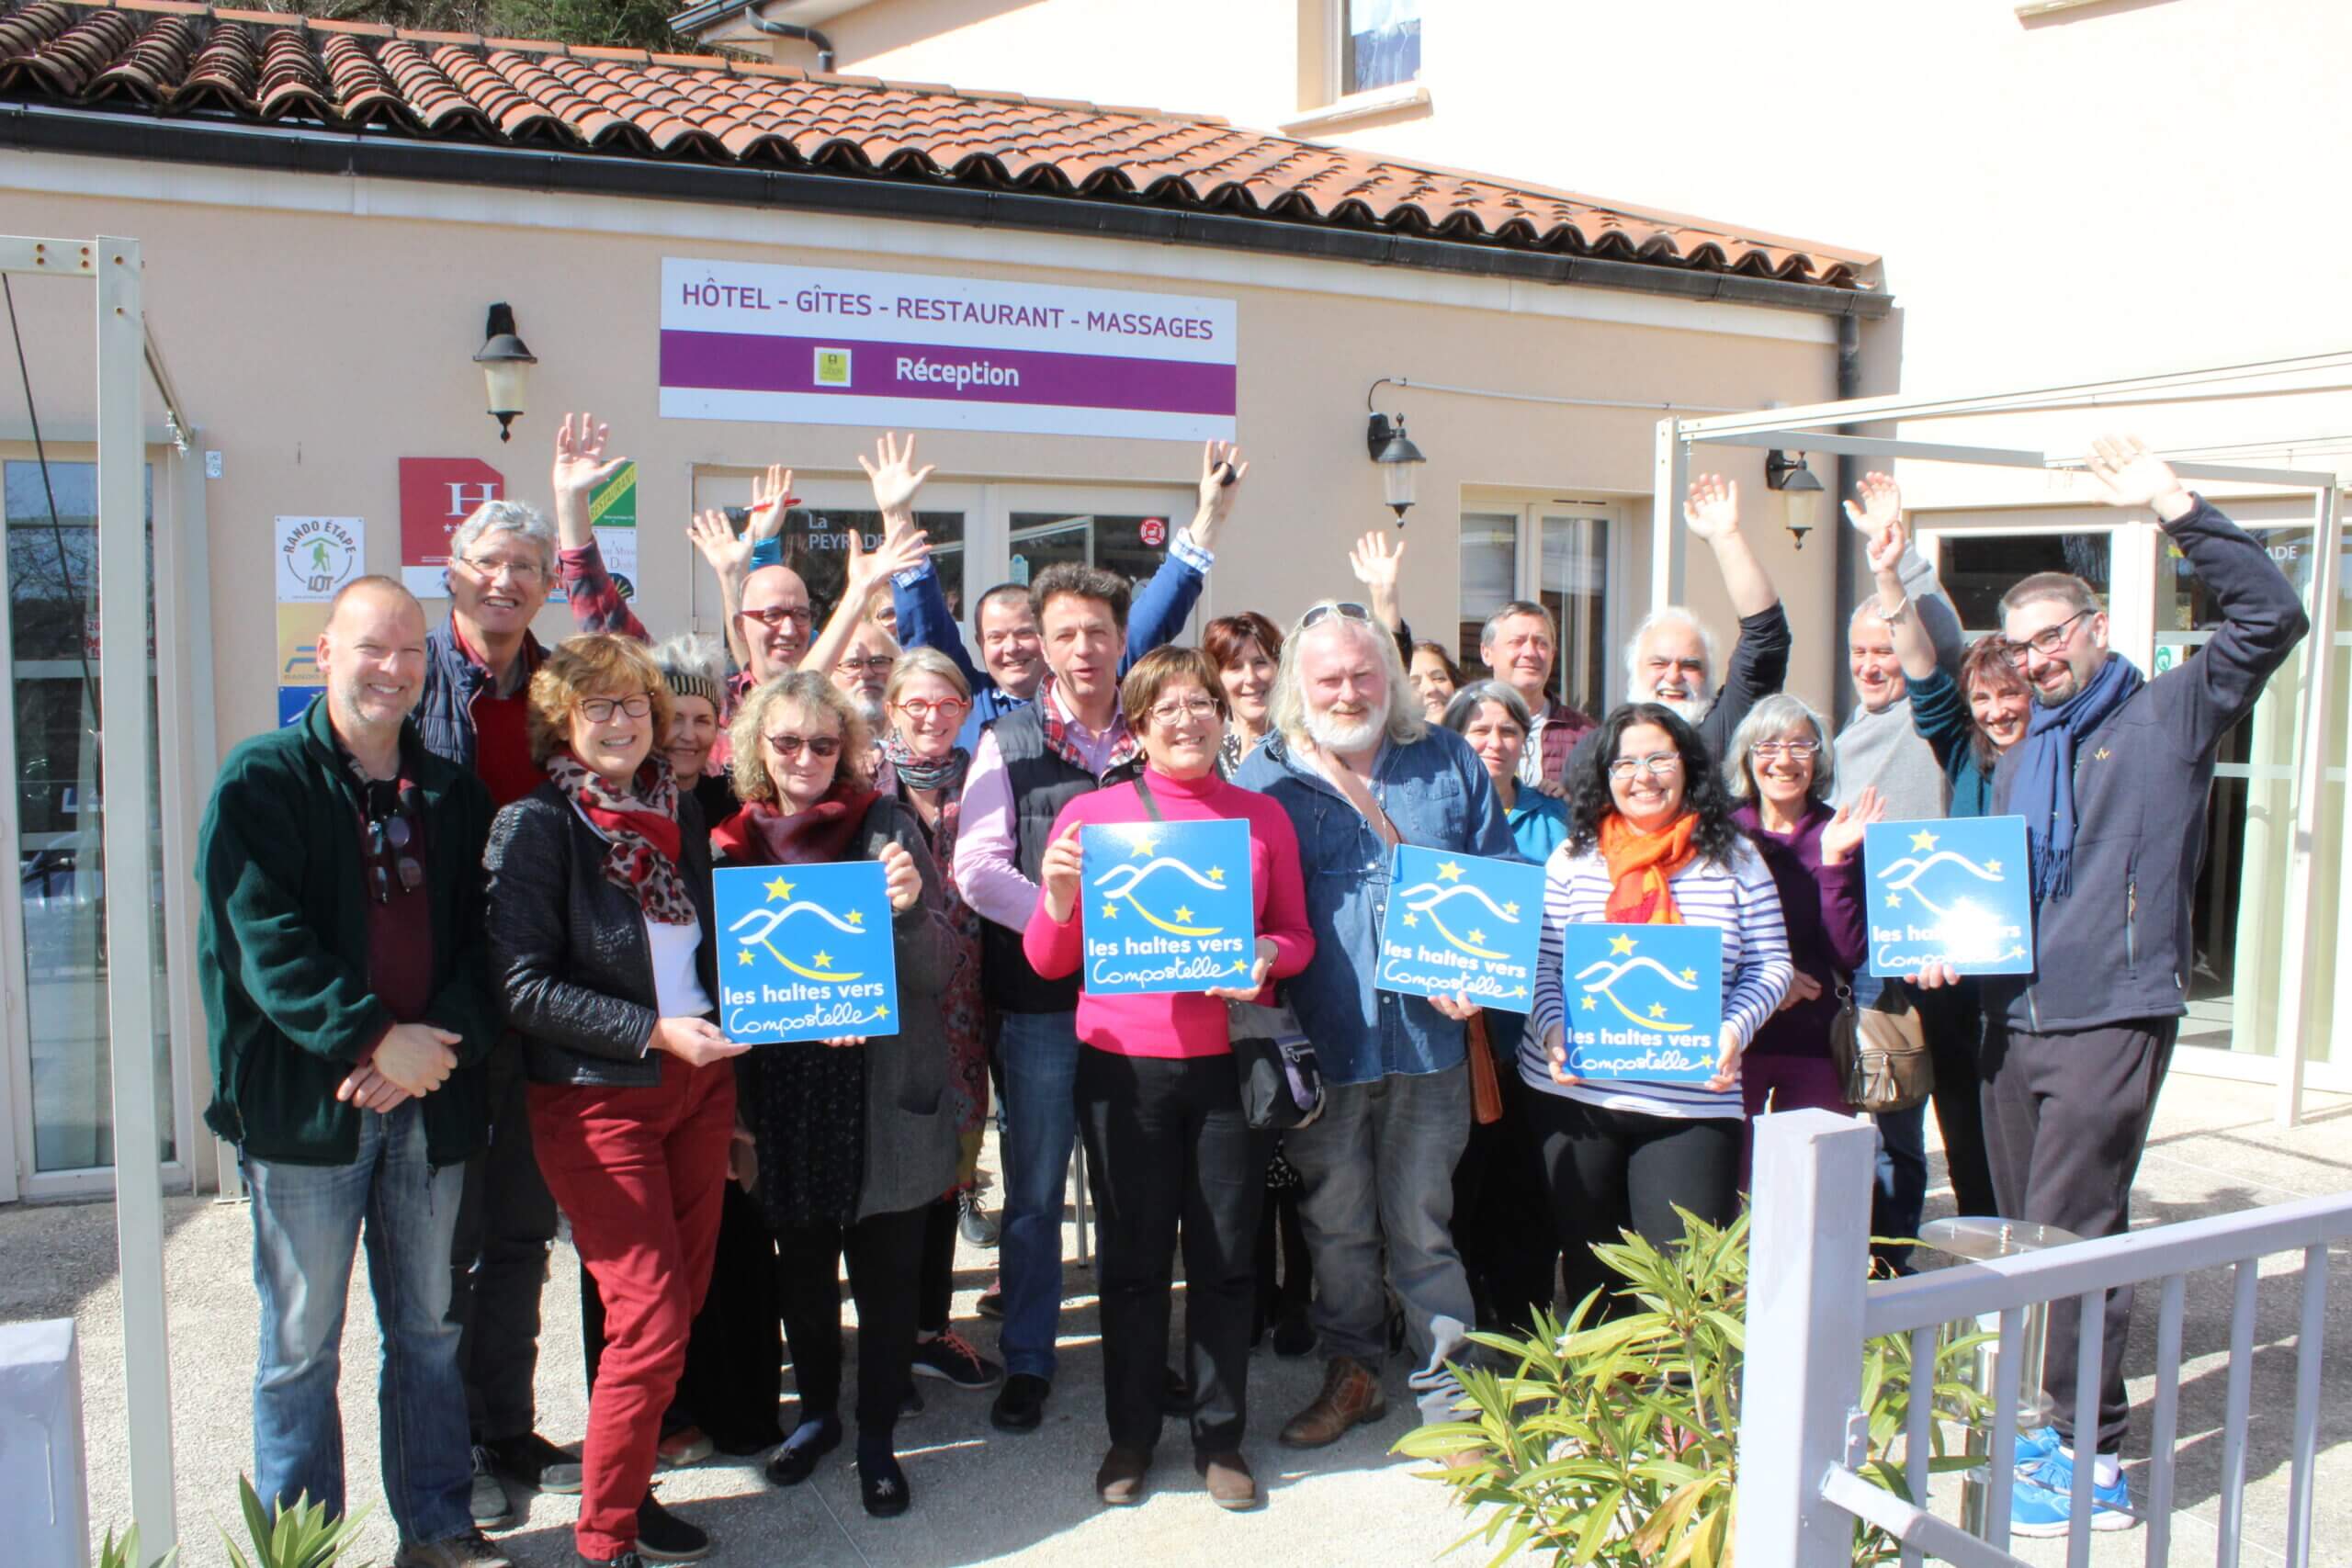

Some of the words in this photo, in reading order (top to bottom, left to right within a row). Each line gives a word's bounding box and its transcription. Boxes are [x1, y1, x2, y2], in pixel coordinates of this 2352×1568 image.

[683, 277, 771, 310] HÔTEL
[797, 285, 872, 316] GÎTES
[897, 297, 1064, 329] RESTAURANT
[1088, 310, 1214, 341] MASSAGES
[896, 356, 1020, 391] Réception
[444, 482, 499, 516] H
[283, 521, 320, 554] RANDO
[808, 513, 827, 529] La
[308, 574, 334, 592] LOT
[1089, 939, 1118, 956] les
[1125, 936, 1191, 954] haltes
[1197, 938, 1242, 953] vers
[1872, 926, 1902, 942] les
[1093, 955, 1236, 988] Compostelle
[1384, 940, 1412, 959] les
[1418, 945, 1478, 971] haltes
[1485, 961, 1527, 978] vers
[725, 987, 755, 1005] les
[763, 983, 831, 1003] haltes
[838, 983, 884, 998] vers
[1384, 959, 1515, 998] Compostelle
[729, 1001, 877, 1037] Compostelle
[1567, 1027, 1595, 1044] les
[1600, 1028, 1662, 1046] haltes
[1668, 1035, 1712, 1047] vers
[1570, 1046, 1702, 1077] Compostelle
